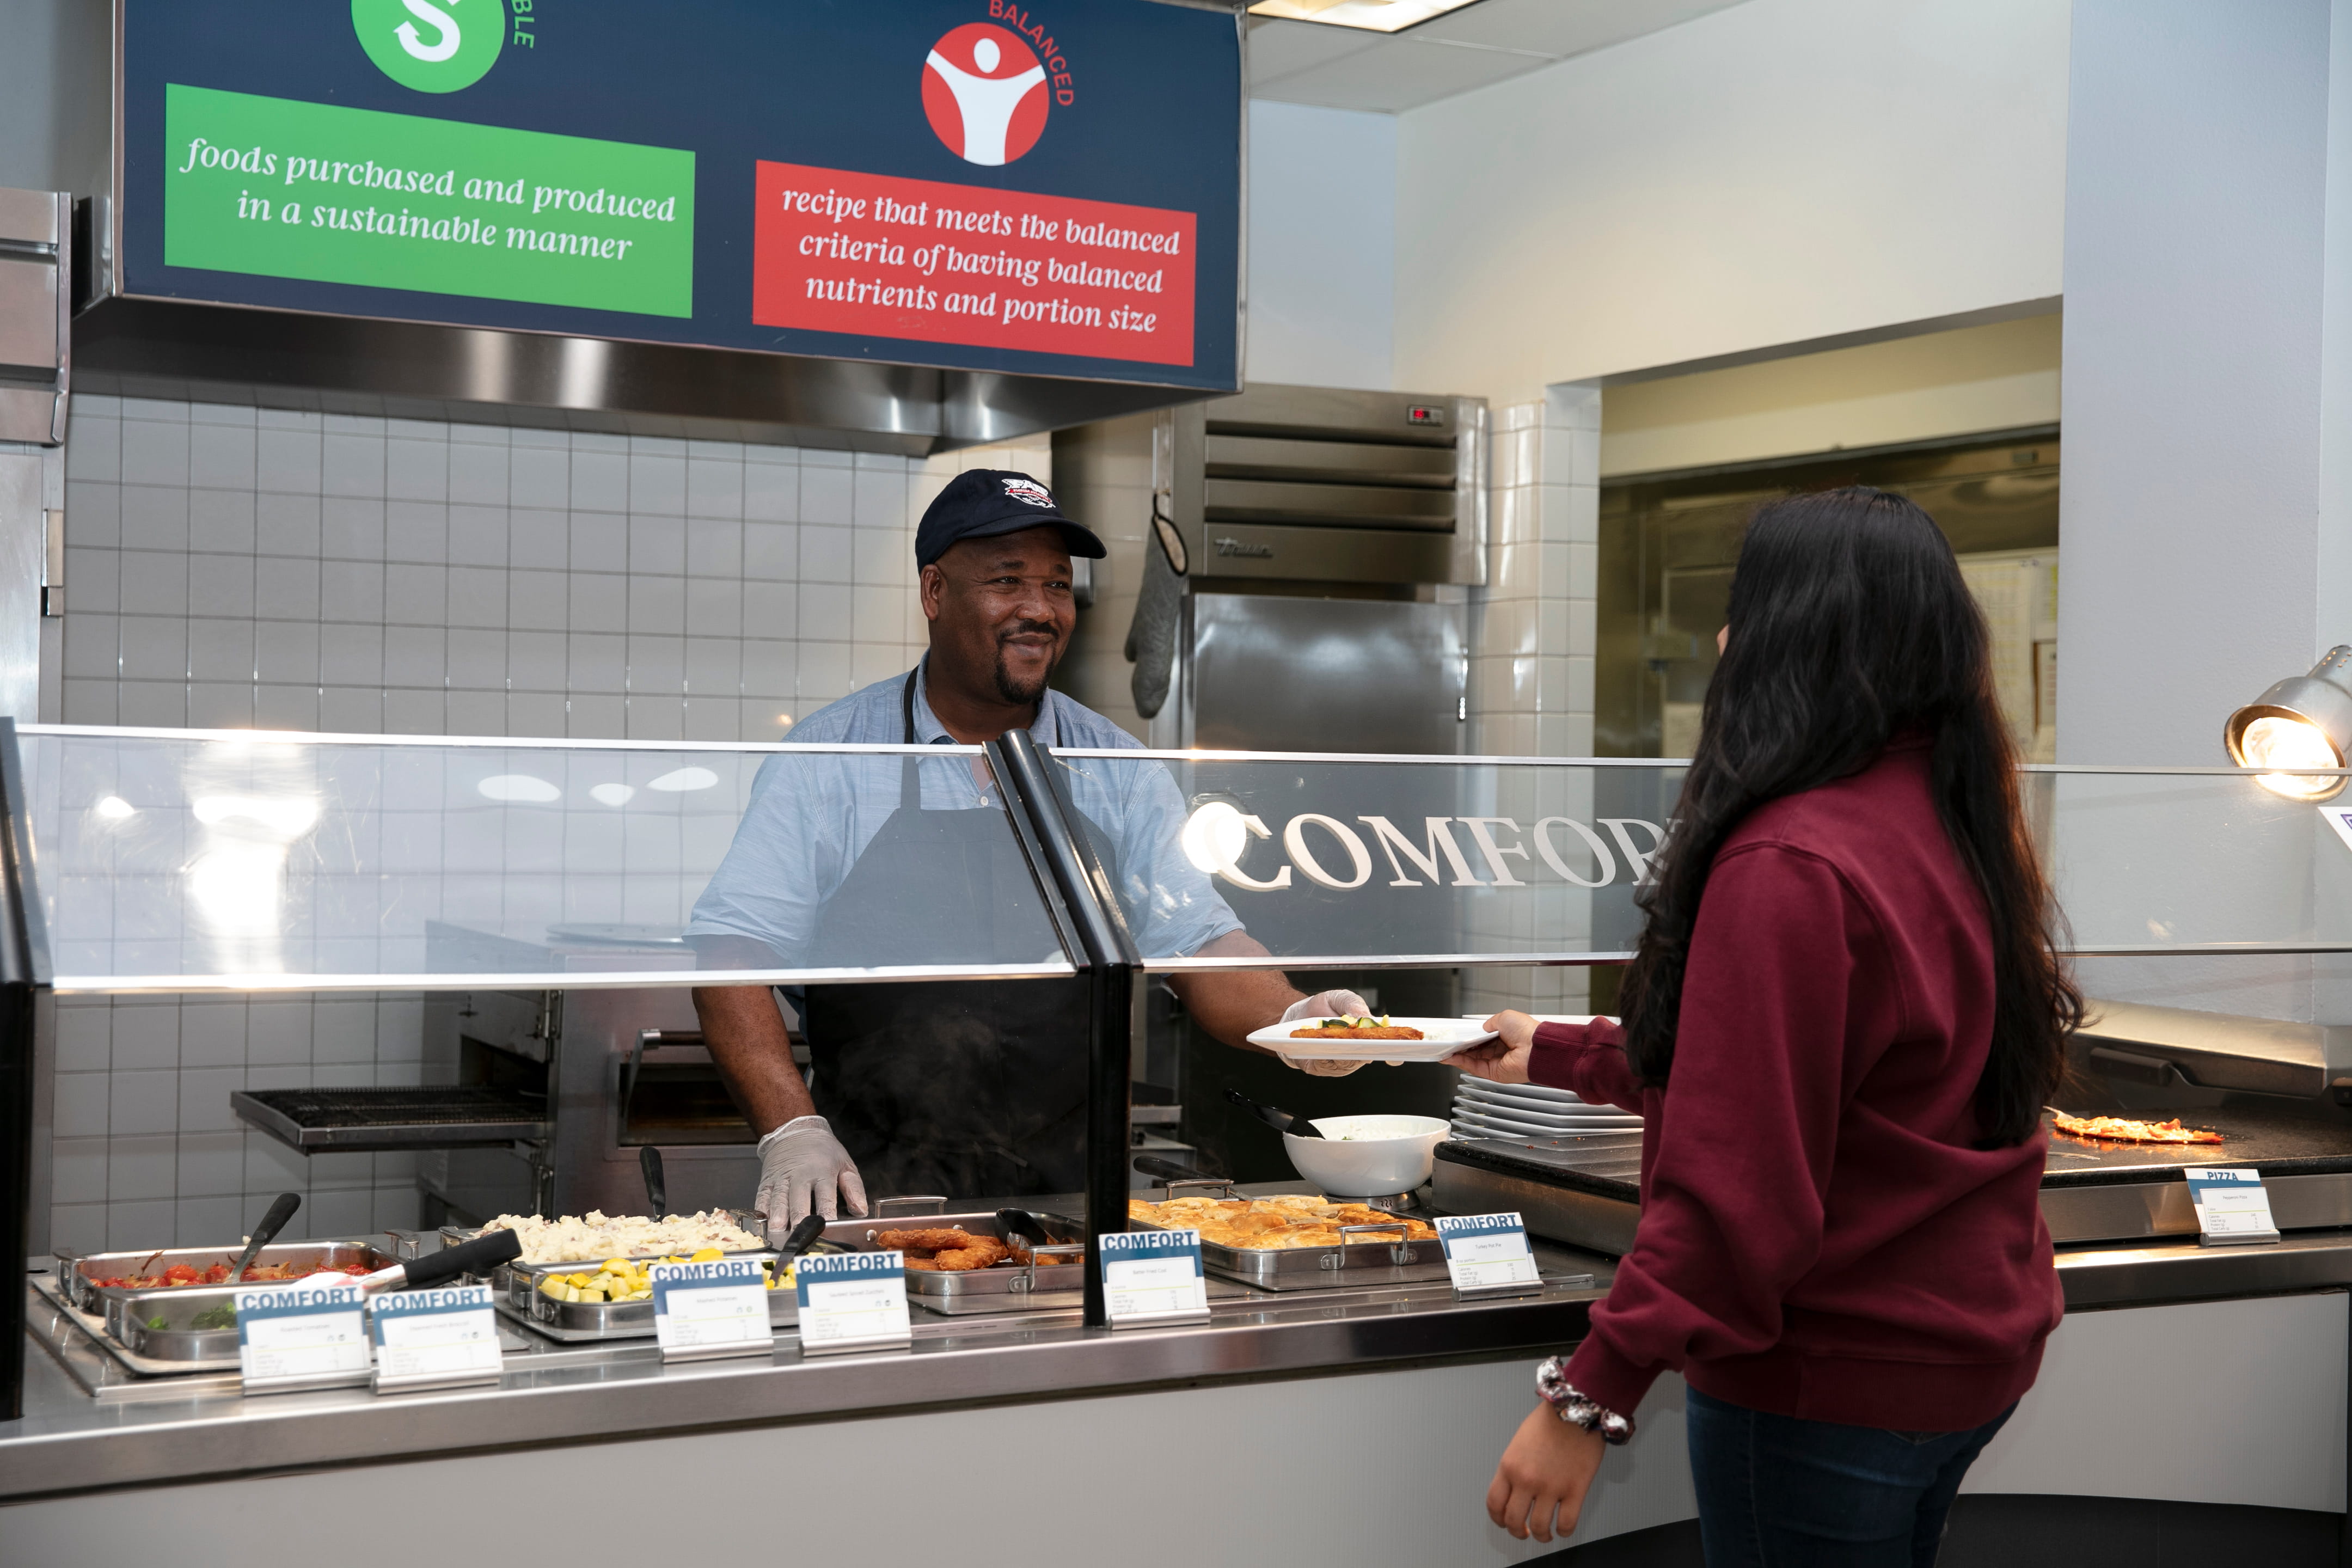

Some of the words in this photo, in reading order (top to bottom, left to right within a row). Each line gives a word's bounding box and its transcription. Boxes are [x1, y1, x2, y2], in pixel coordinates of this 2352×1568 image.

[989, 0, 1074, 106] BALANCED
[179, 137, 278, 176] foods
[284, 156, 455, 197] purchased
[463, 177, 525, 205] and
[532, 186, 676, 222] produced
[237, 189, 272, 222] in
[281, 203, 302, 225] a
[310, 205, 497, 246] sustainable
[506, 227, 633, 261] manner
[782, 188, 867, 224] recipe
[874, 196, 929, 226] that
[935, 207, 1014, 236] meets
[1020, 213, 1059, 242] the
[1065, 218, 1180, 256] balanced
[799, 231, 906, 266] criteria
[912, 243, 946, 277] of
[946, 246, 1042, 287] having
[1047, 256, 1163, 294] balanced
[806, 277, 938, 311] nutrients
[943, 291, 997, 317] and
[1002, 297, 1102, 328] portion
[1107, 304, 1157, 333] size
[1202, 812, 1685, 891] COMFOR
[2207, 1172, 2239, 1180] PIZZA
[1104, 1232, 1194, 1250] COMFORT
[1440, 1215, 1516, 1230] COMFORT
[655, 1261, 755, 1281] COMFORT
[799, 1254, 897, 1273] COMFORT
[242, 1287, 358, 1309] COMFORT
[375, 1288, 486, 1311] COMFORT
